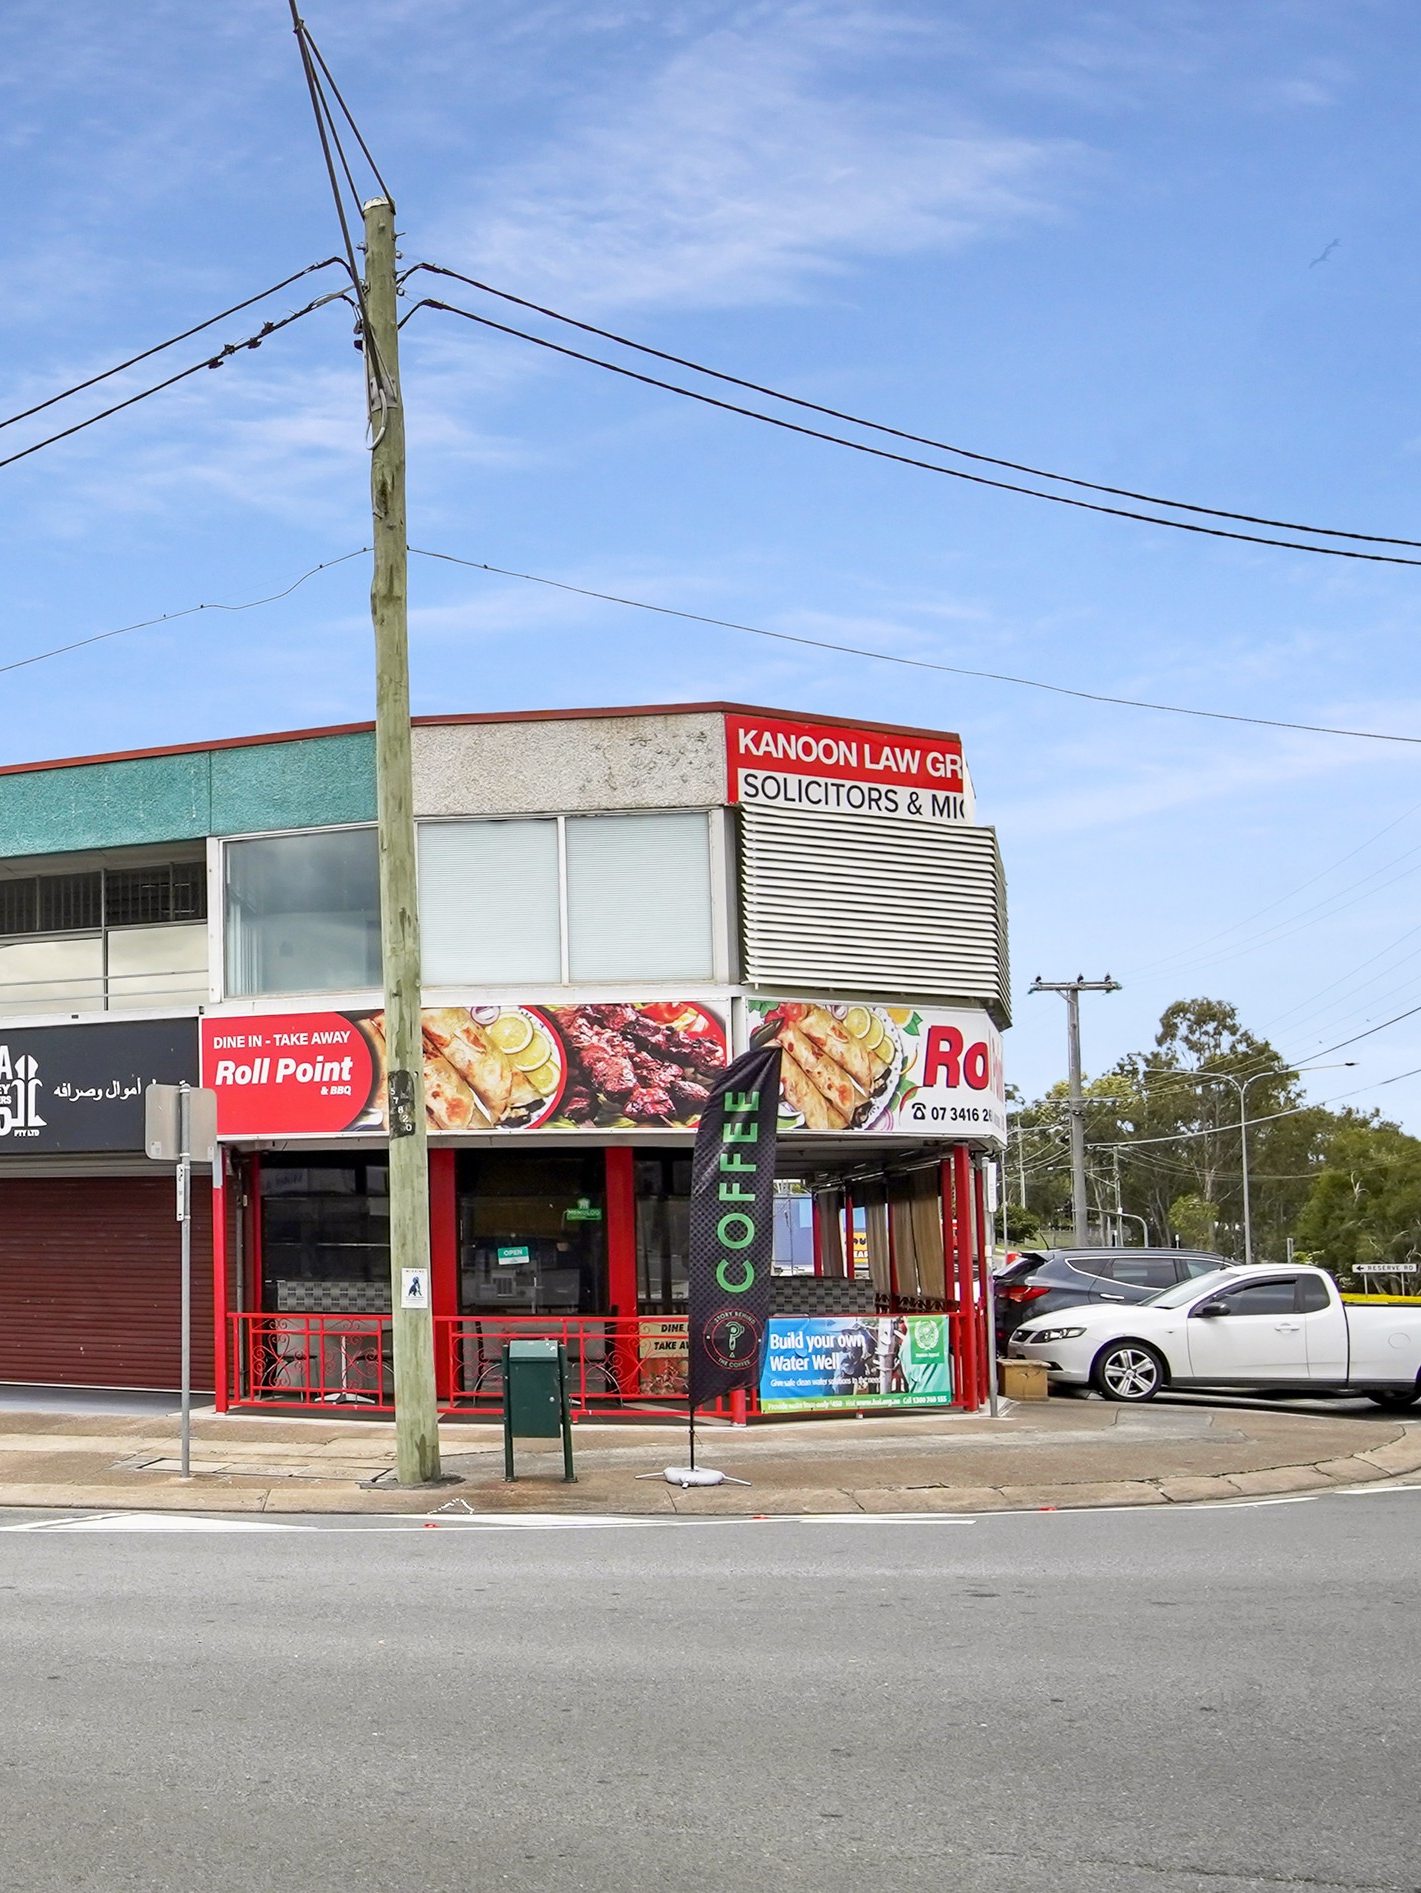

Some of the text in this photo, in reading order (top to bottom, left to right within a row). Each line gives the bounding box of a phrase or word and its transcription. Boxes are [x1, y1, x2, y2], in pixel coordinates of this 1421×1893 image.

[738, 728, 963, 780] KANOON LAW GR
[744, 773, 964, 820] SOLICITORS & MI
[213, 1036, 246, 1049] DINE
[248, 1034, 262, 1048] IN
[274, 1033, 309, 1047] TAKE
[311, 1030, 351, 1045] AWAY
[923, 1025, 990, 1091] Ro
[215, 1056, 353, 1086] Roll Point
[320, 1085, 352, 1097] & BBQ
[931, 1107, 979, 1121] 07 3416
[716, 1091, 760, 1293] COFFEE
[714, 1311, 756, 1324] STORY BEHIND
[661, 1324, 684, 1332] DINE
[654, 1341, 677, 1350] TAKE
[770, 1332, 865, 1353] Build your own
[718, 1358, 728, 1366] THE
[770, 1353, 840, 1372] Water Well
[796, 1378, 811, 1386] clean
